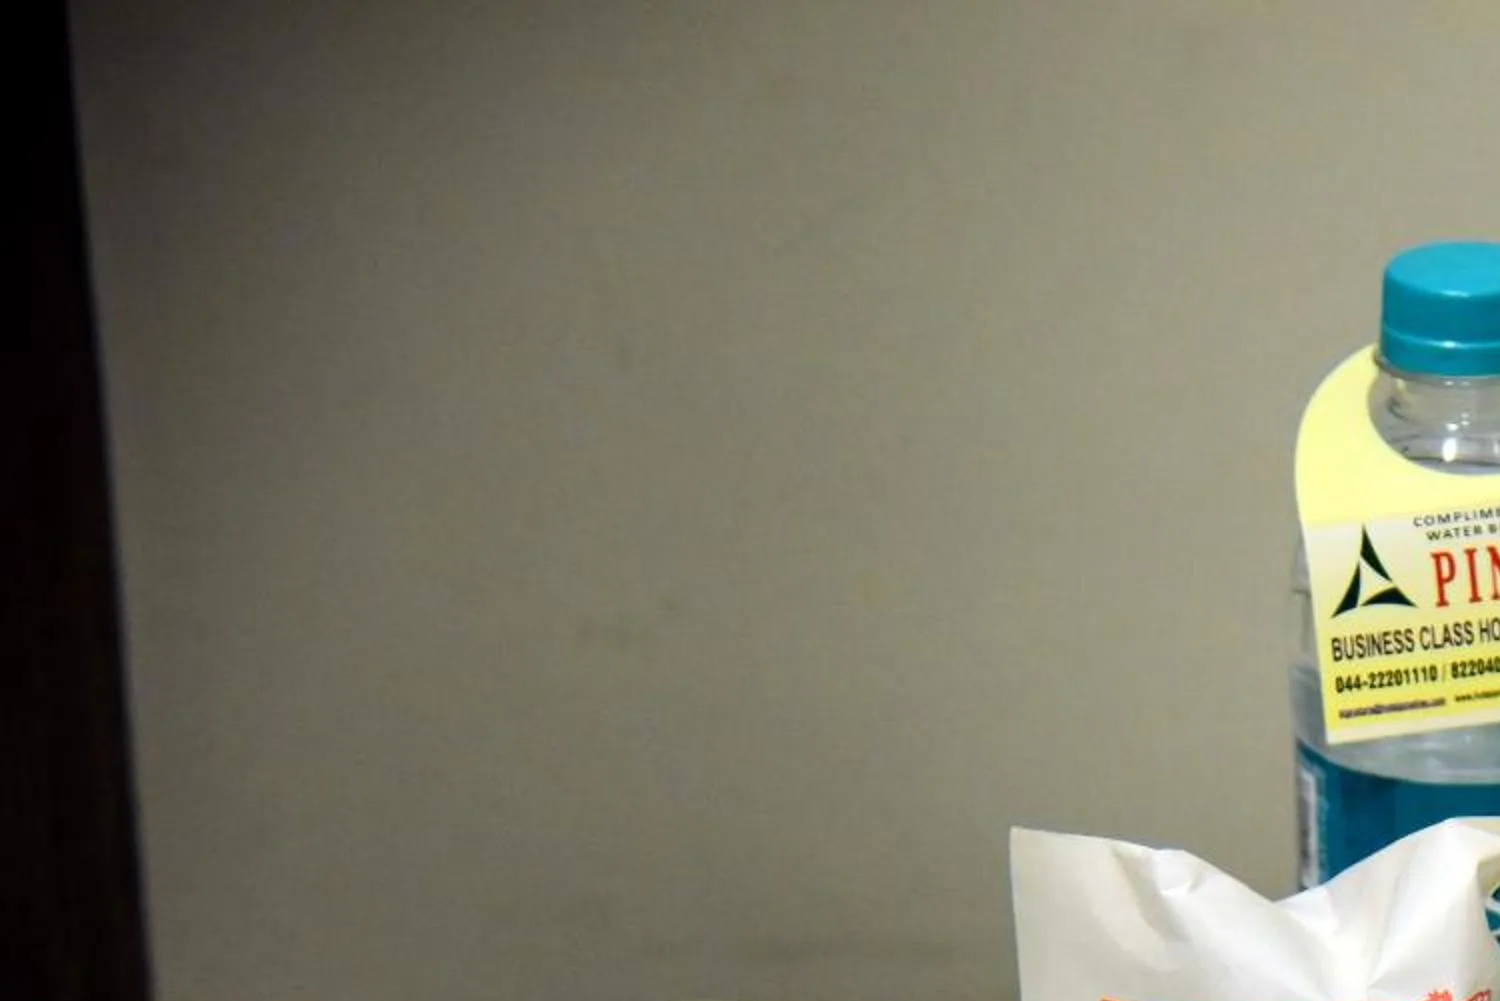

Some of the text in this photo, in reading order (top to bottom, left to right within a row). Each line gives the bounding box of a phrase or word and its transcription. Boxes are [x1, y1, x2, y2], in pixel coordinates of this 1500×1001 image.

[1426, 524, 1482, 541] WATER
[1330, 625, 1415, 662] BUSINESS
[1419, 619, 1476, 650] CLASS
[1335, 664, 1438, 693] 044-22201110
